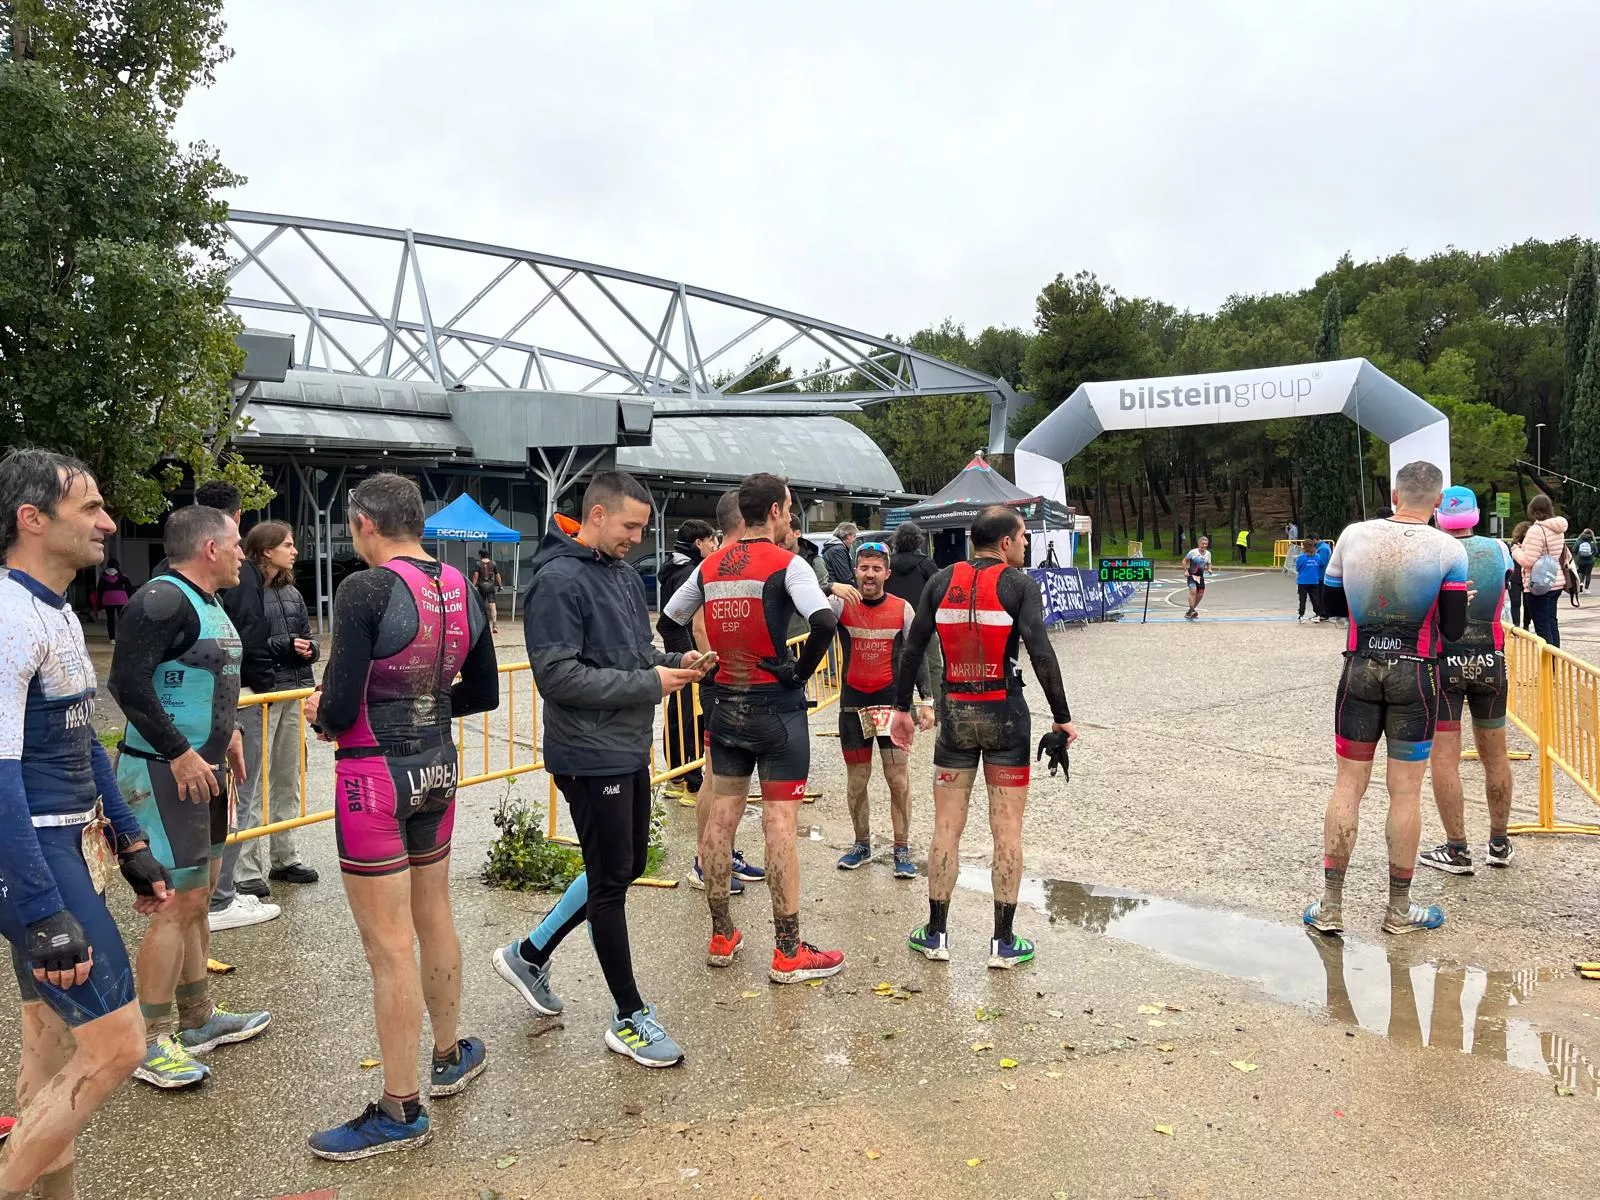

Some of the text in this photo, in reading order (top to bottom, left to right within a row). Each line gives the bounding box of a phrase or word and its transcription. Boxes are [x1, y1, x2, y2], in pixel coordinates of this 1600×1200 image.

[436, 529, 488, 539] DECATHLON
[711, 599, 751, 620] SERGIO
[721, 621, 740, 632] ESP
[1368, 635, 1402, 650] CIUDAD
[861, 652, 879, 660] ESP
[1446, 653, 1495, 667] ROZAS
[1461, 667, 1482, 680] ESP
[407, 762, 457, 795] LAMBEA
[344, 778, 362, 813] BMZ
